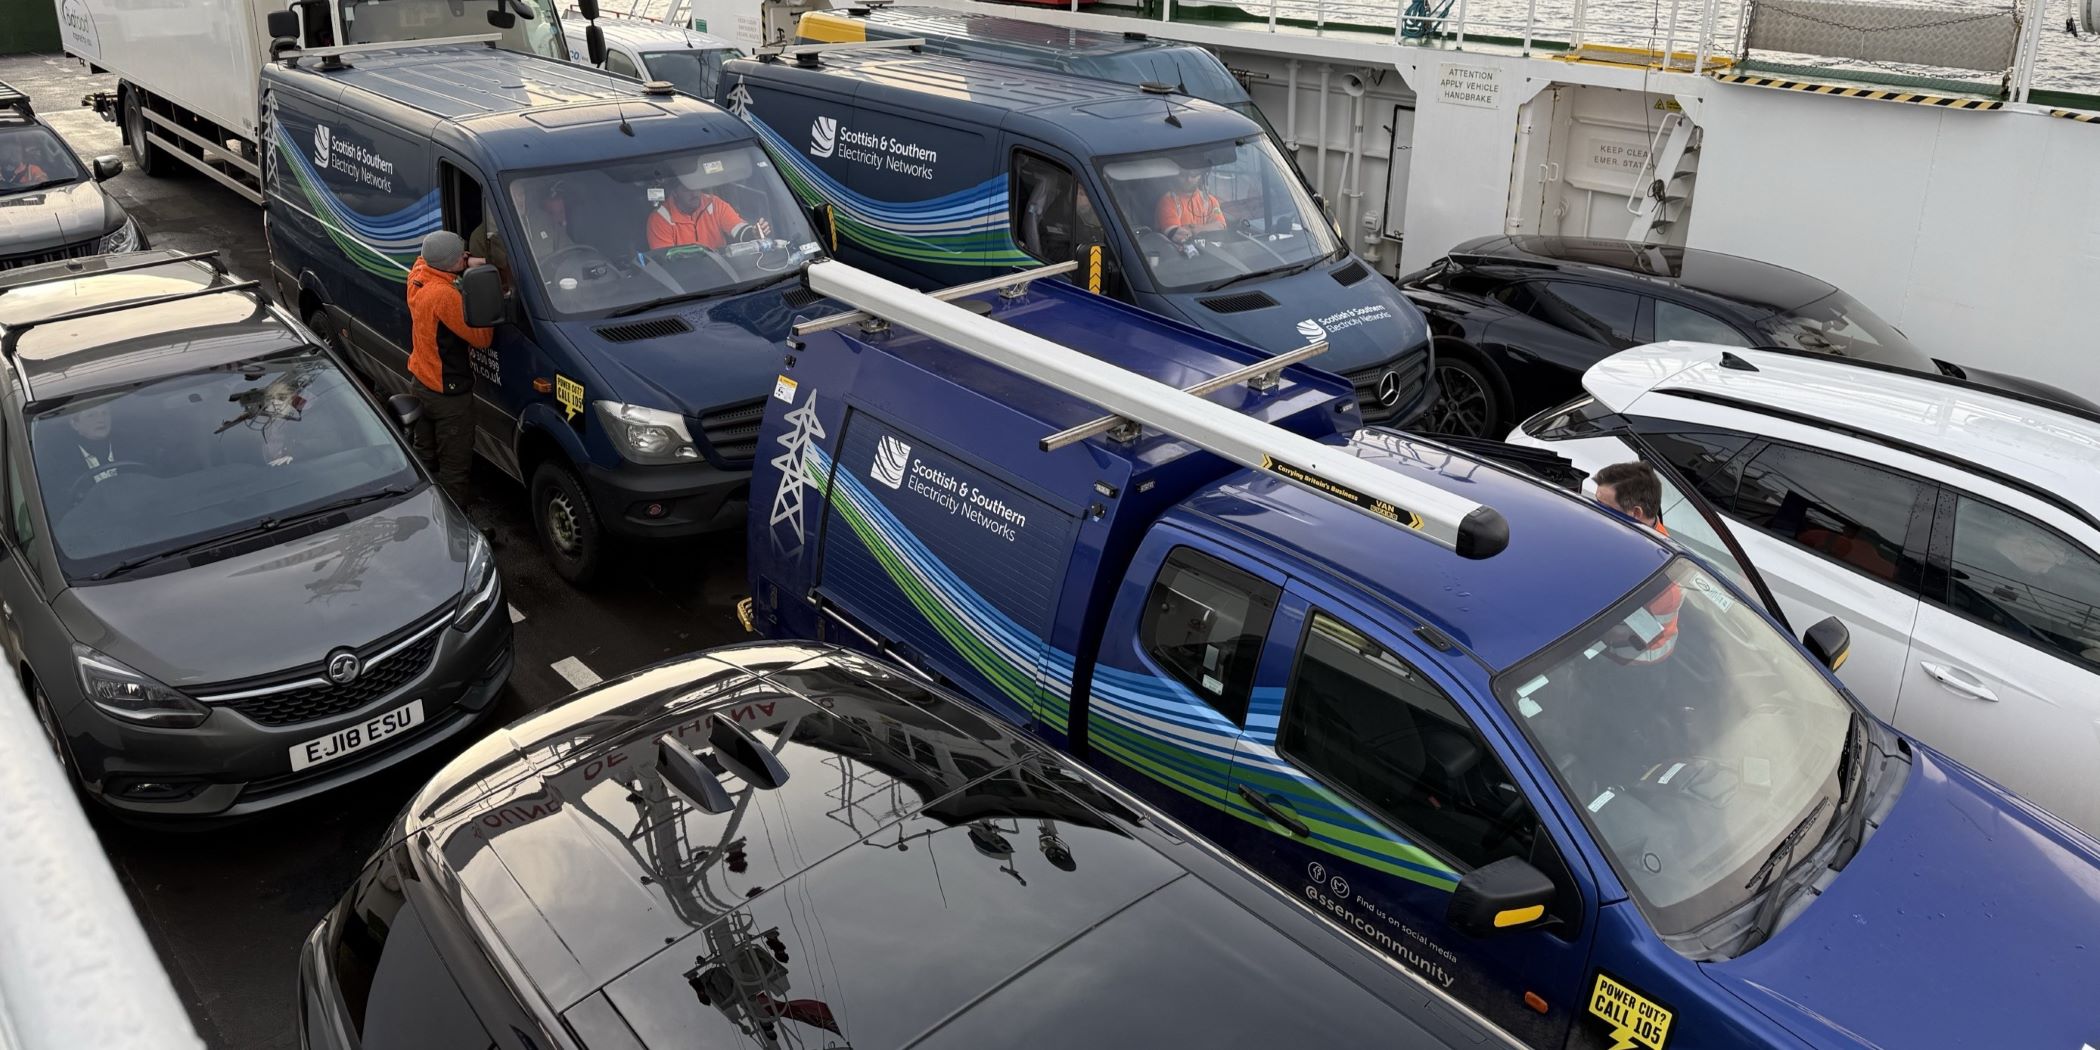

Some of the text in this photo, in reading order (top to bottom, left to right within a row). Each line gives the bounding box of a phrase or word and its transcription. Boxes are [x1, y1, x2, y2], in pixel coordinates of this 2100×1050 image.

[1440, 79, 1499, 93] APPLY VEHICLE
[1448, 68, 1493, 81] ATTENTION
[1444, 90, 1492, 104] HANDBRAKE
[331, 135, 393, 175] Scottish & Southern
[838, 143, 933, 180] Electricity Networks
[840, 126, 937, 163] Scottish & Southern
[1600, 144, 1649, 159] KEEP CLEA
[331, 152, 392, 194] Electricity Networks
[1622, 160, 1658, 171] STATON
[1318, 310, 1350, 326] Scottish
[1353, 304, 1386, 316] Southern
[1326, 311, 1392, 333] Electricity Networks
[557, 377, 583, 397] POWER CUT?
[557, 387, 582, 409] CALL 105
[911, 458, 1026, 528] Scottish & Southern
[1277, 464, 1359, 502] Carrying Britain's Business
[907, 475, 1016, 542] Electricity Networks
[1375, 499, 1395, 513] VAN
[305, 707, 412, 763] EJ18 ESU
[1305, 885, 1455, 988] @ssencommunity
[1356, 895, 1457, 964] Find us on social media
[1594, 994, 1662, 1045] CALL 105
[1599, 979, 1667, 1026] POWER CUT?
